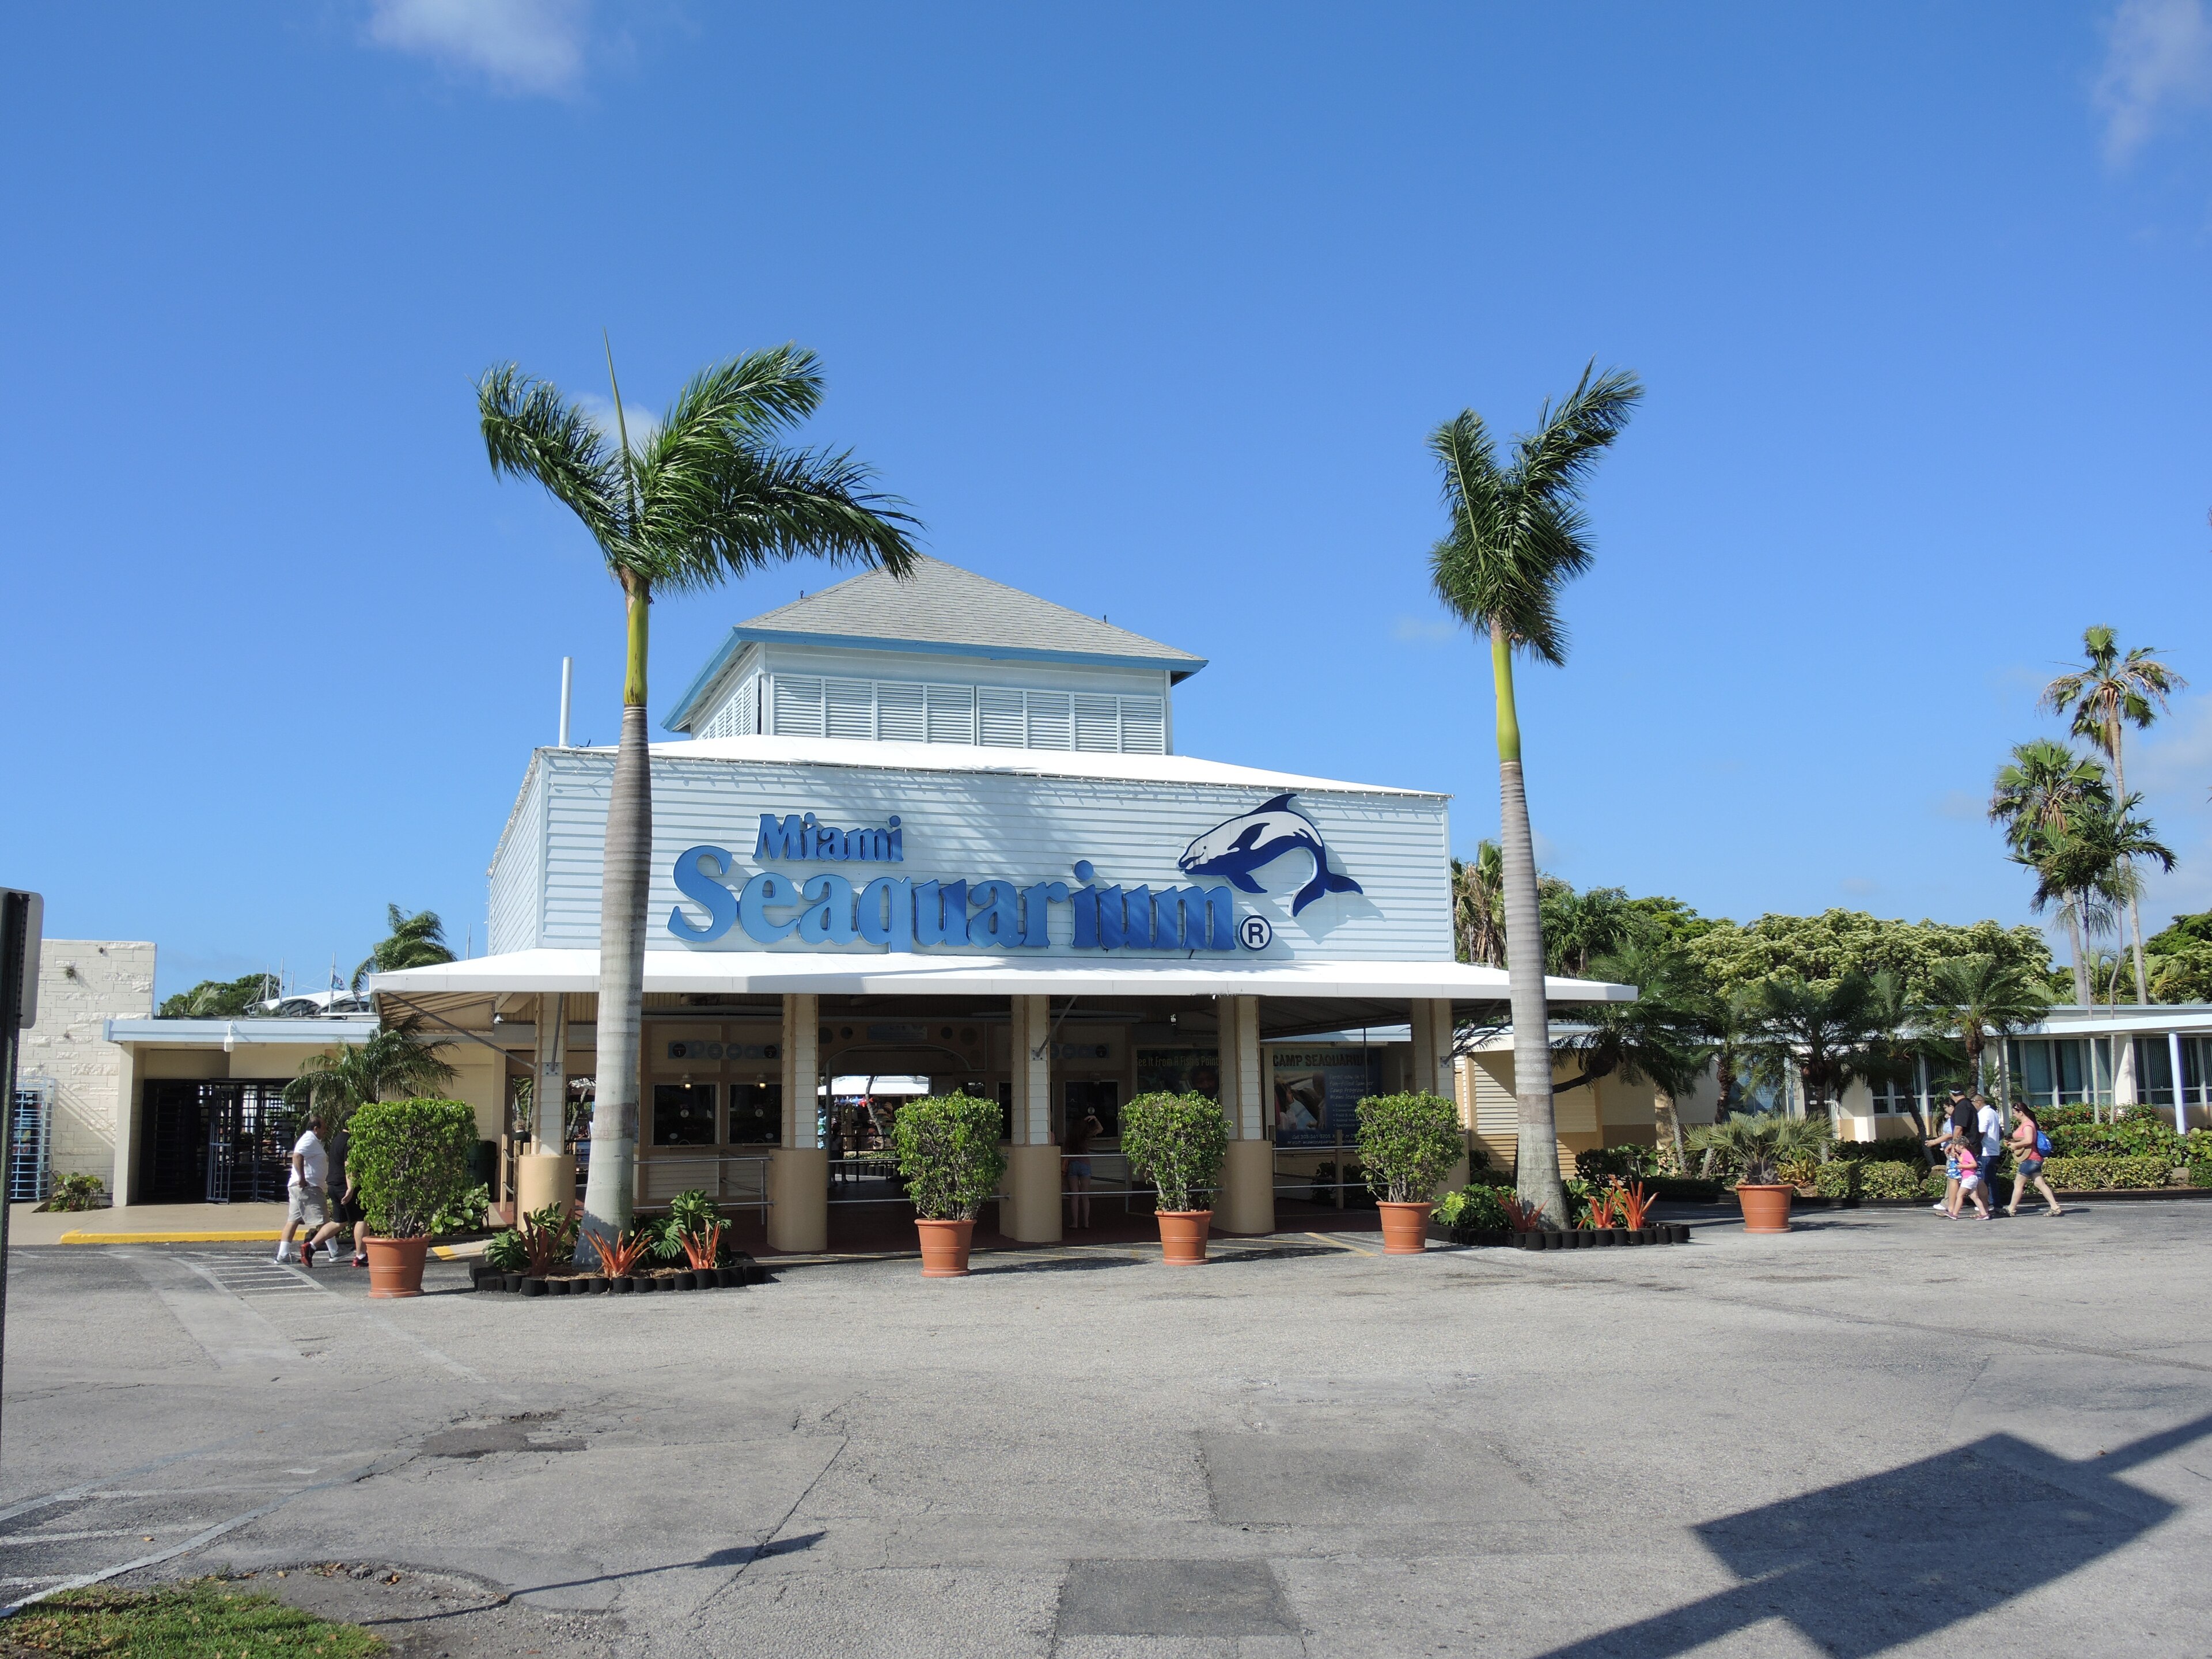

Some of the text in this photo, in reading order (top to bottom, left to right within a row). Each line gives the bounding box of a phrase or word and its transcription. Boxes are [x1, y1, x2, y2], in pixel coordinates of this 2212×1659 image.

[752, 812, 904, 862] Miami
[666, 845, 1236, 954] Seaquarium
[1148, 1056, 1154, 1066] It
[1156, 1056, 1172, 1067] From
[1174, 1056, 1179, 1066] A
[1273, 1054, 1373, 1067] CAMP SEAQUARIUM
